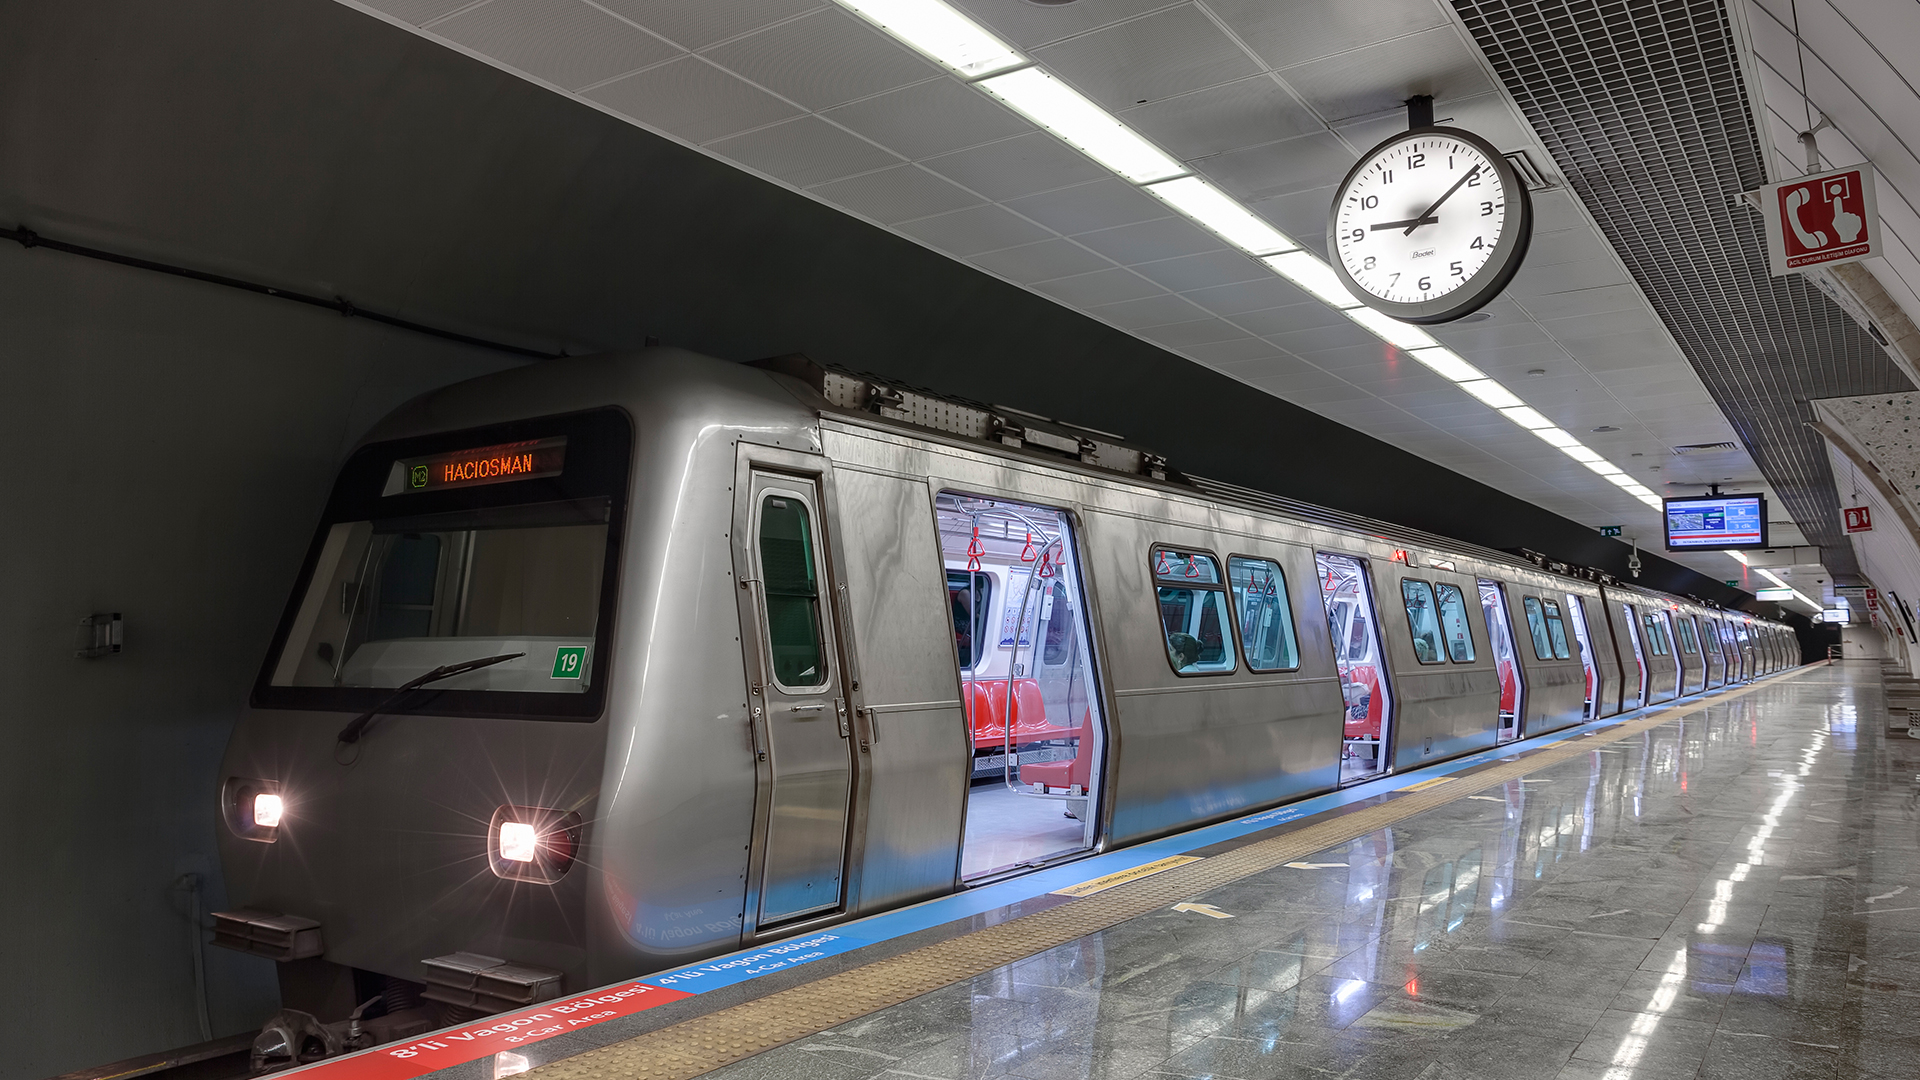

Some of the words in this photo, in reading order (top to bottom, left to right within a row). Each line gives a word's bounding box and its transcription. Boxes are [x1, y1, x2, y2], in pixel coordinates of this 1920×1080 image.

[1408, 154, 1425, 170] 12
[1449, 156, 1453, 169] 1
[1382, 170, 1393, 184] 11
[1467, 172, 1481, 187] 2
[1361, 195, 1378, 210] 10
[1480, 201, 1493, 216] 3
[1352, 228, 1365, 242] 9
[1469, 236, 1484, 251] 4
[1412, 249, 1434, 259] Bodet
[1802, 255, 1821, 264] DURUM
[1363, 256, 1377, 271] 8
[1450, 261, 1463, 276] 5
[1388, 272, 1401, 288] 7
[1418, 276, 1431, 291] 6
[444, 454, 533, 482] HACIOSMAN
[561, 653, 578, 672] 19
[659, 970, 705, 986] 4'lü
[700, 953, 773, 973] Vagon
[768, 934, 840, 956] Bölgesi
[746, 960, 787, 976] 4-Car
[787, 951, 825, 963] Area
[390, 1040, 449, 1059] 8'li
[446, 1012, 554, 1042] Vagon
[551, 984, 654, 1015] Bölgesi
[504, 1023, 564, 1044] 8-Car
[567, 1010, 617, 1026] Area
